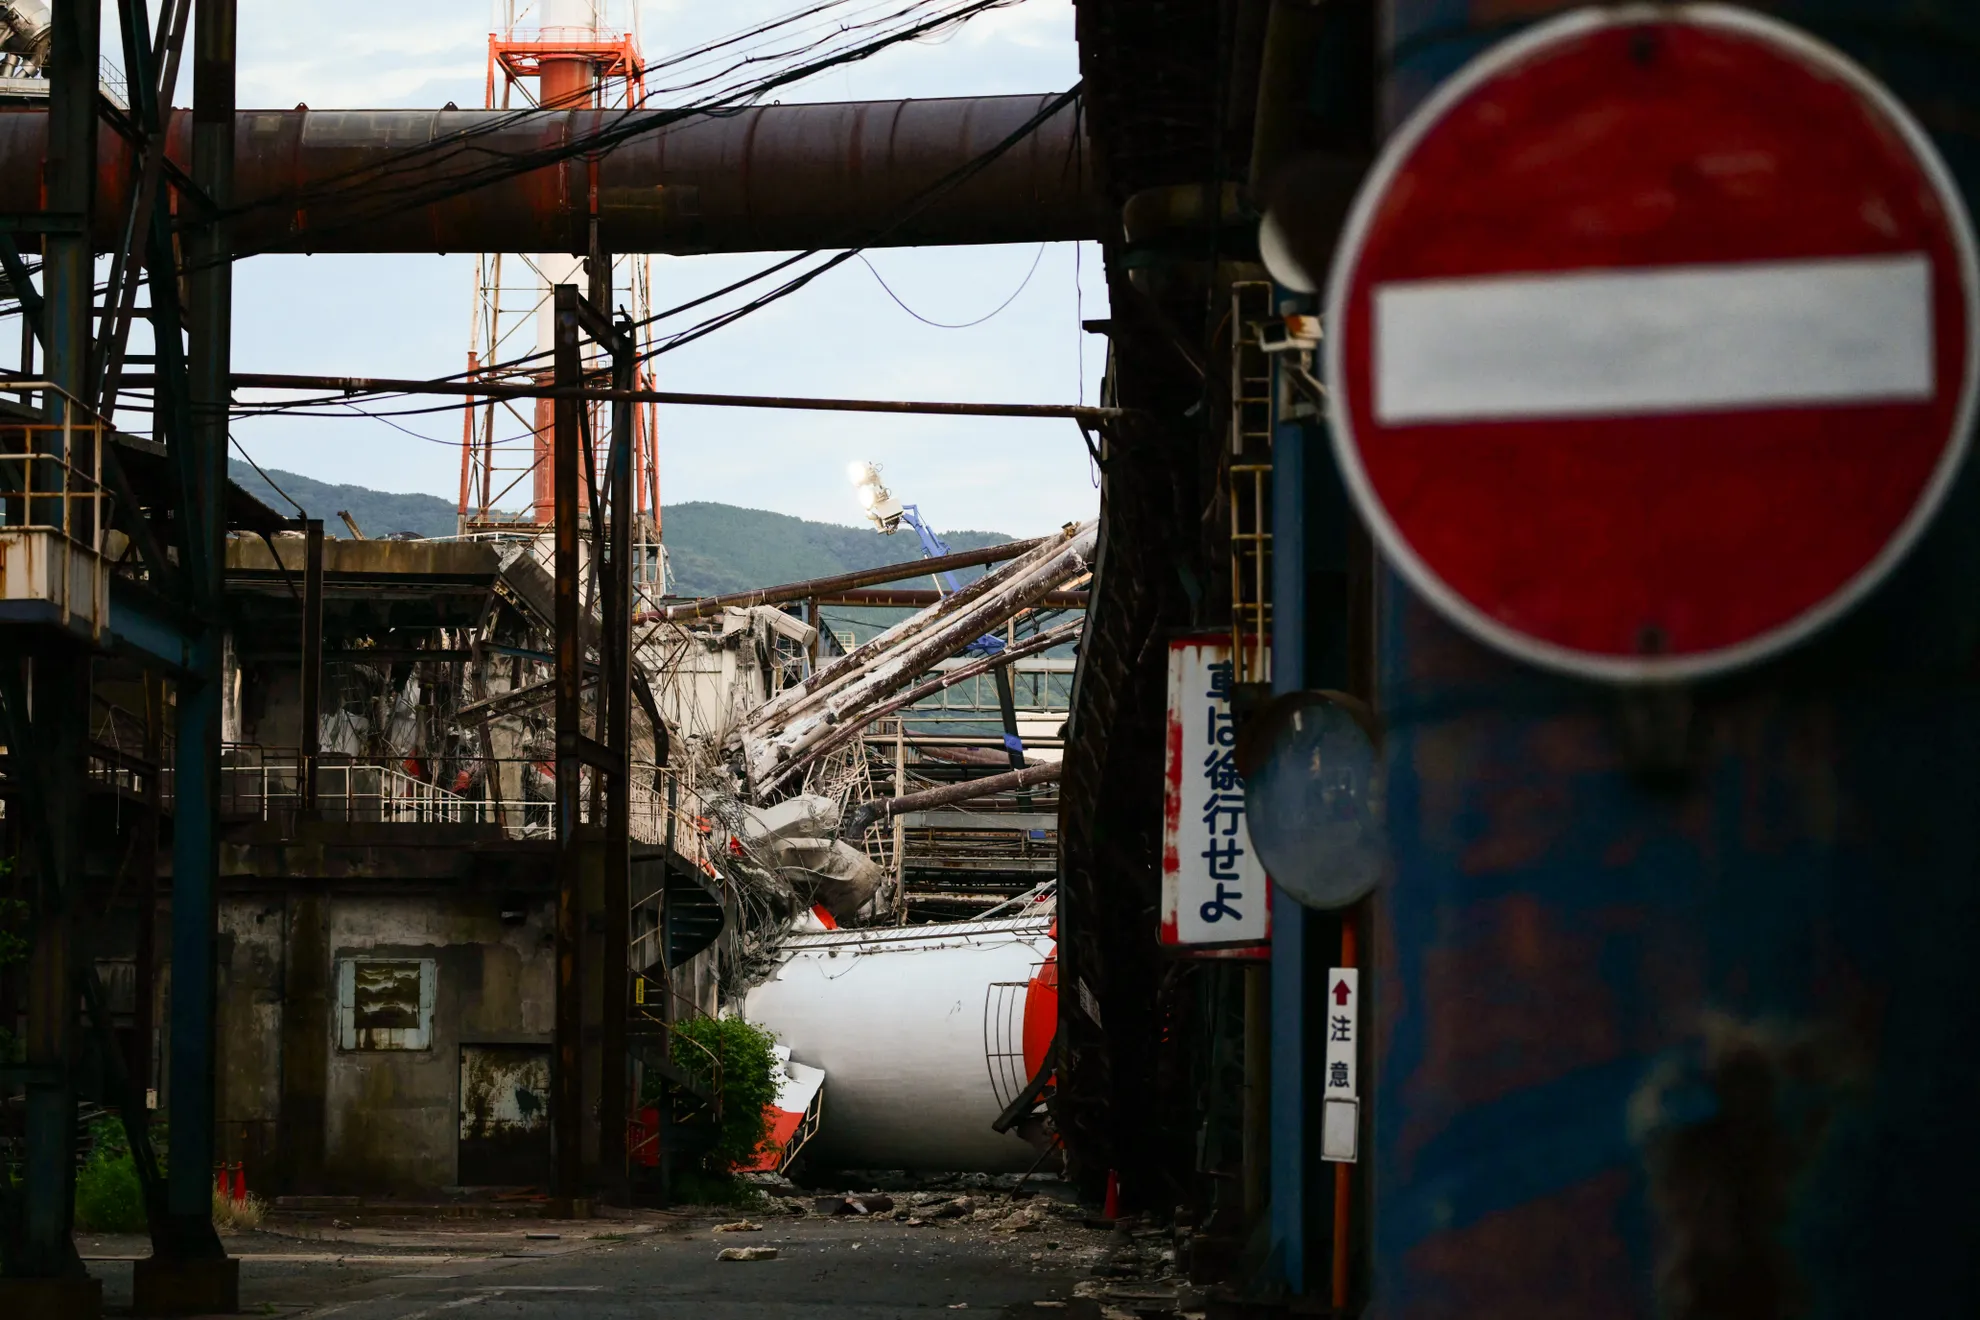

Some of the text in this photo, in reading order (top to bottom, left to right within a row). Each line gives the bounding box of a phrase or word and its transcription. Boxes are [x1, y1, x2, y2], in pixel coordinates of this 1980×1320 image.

[1200, 659, 1247, 923] 車は徐行せよ
[1328, 1015, 1352, 1088] 注意
